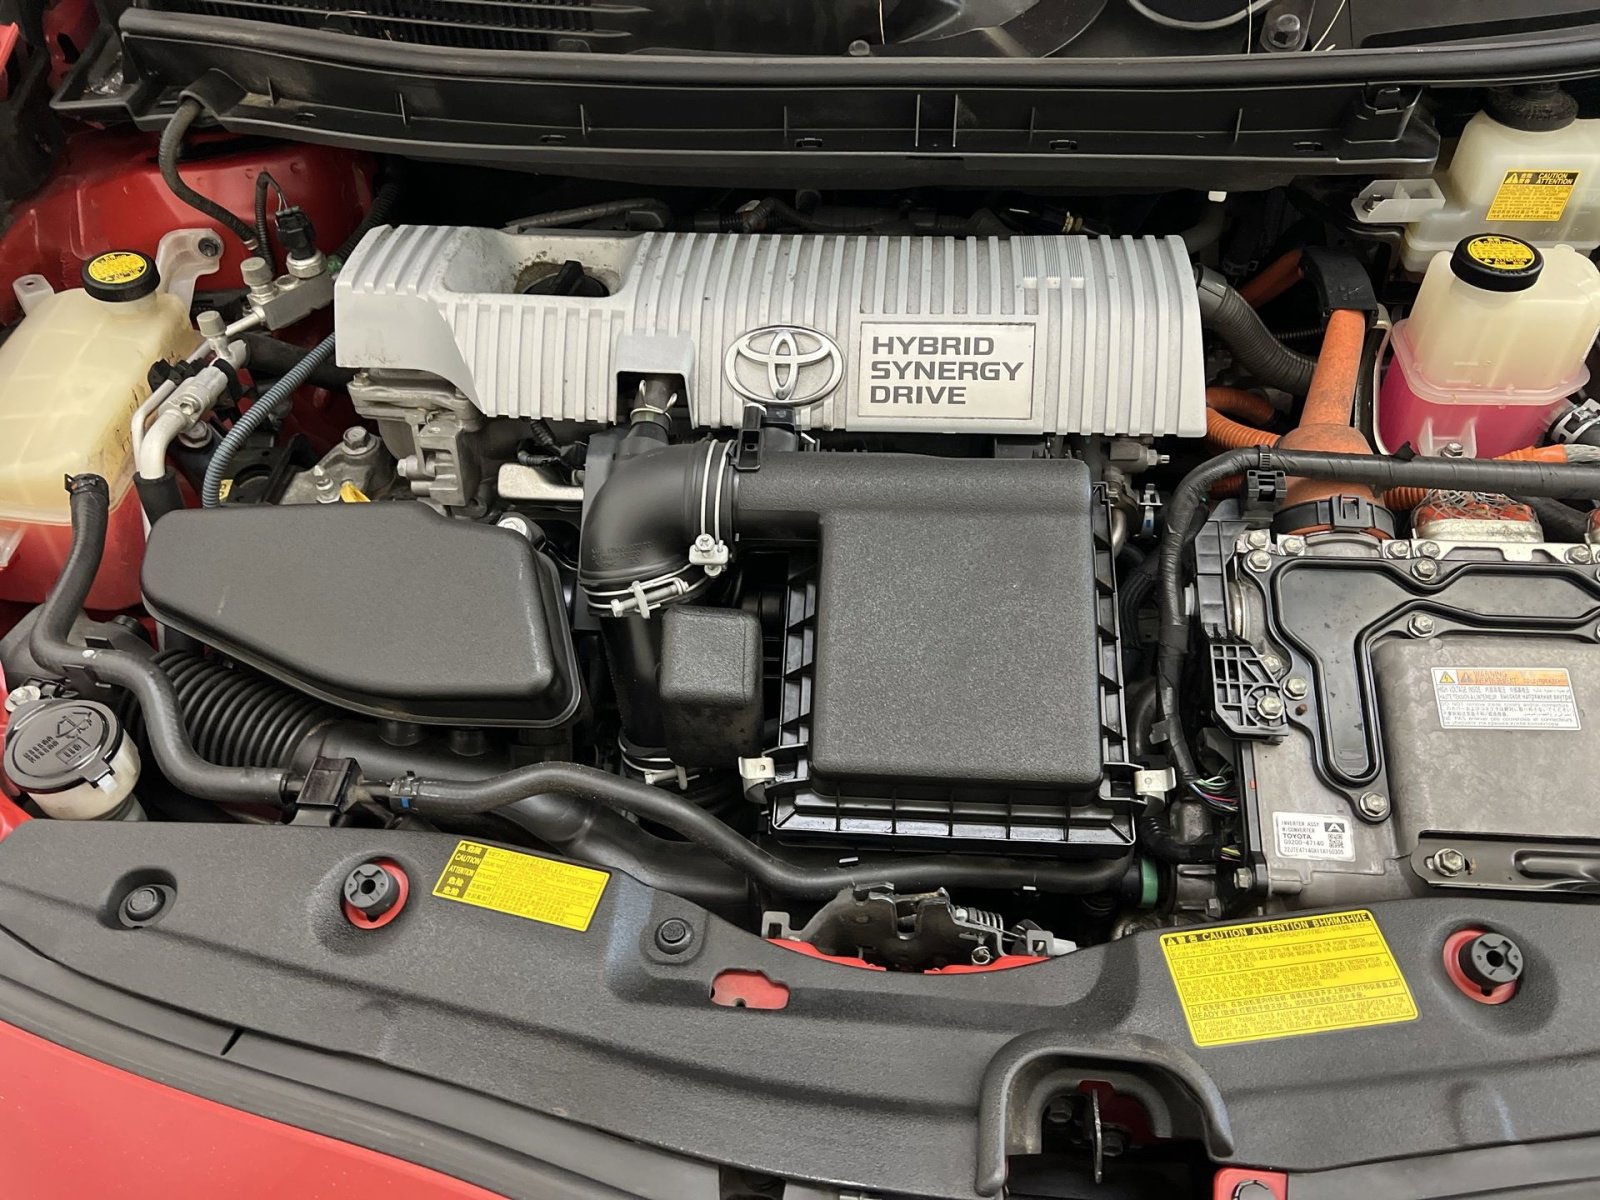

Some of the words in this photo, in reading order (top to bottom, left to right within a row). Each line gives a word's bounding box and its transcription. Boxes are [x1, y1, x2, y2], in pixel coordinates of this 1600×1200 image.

[872, 336, 995, 356] HYBRID
[871, 361, 1024, 381] SYNERGY
[870, 385, 967, 405] DRIVE
[455, 854, 481, 865] CAUTION
[449, 866, 475, 877] ATTENTION
[1202, 928, 1248, 941] CAUTION
[1252, 922, 1309, 935] ATTENTION
[1313, 913, 1368, 927] ВНИМАНИЕ
[1191, 1010, 1219, 1019] READY
